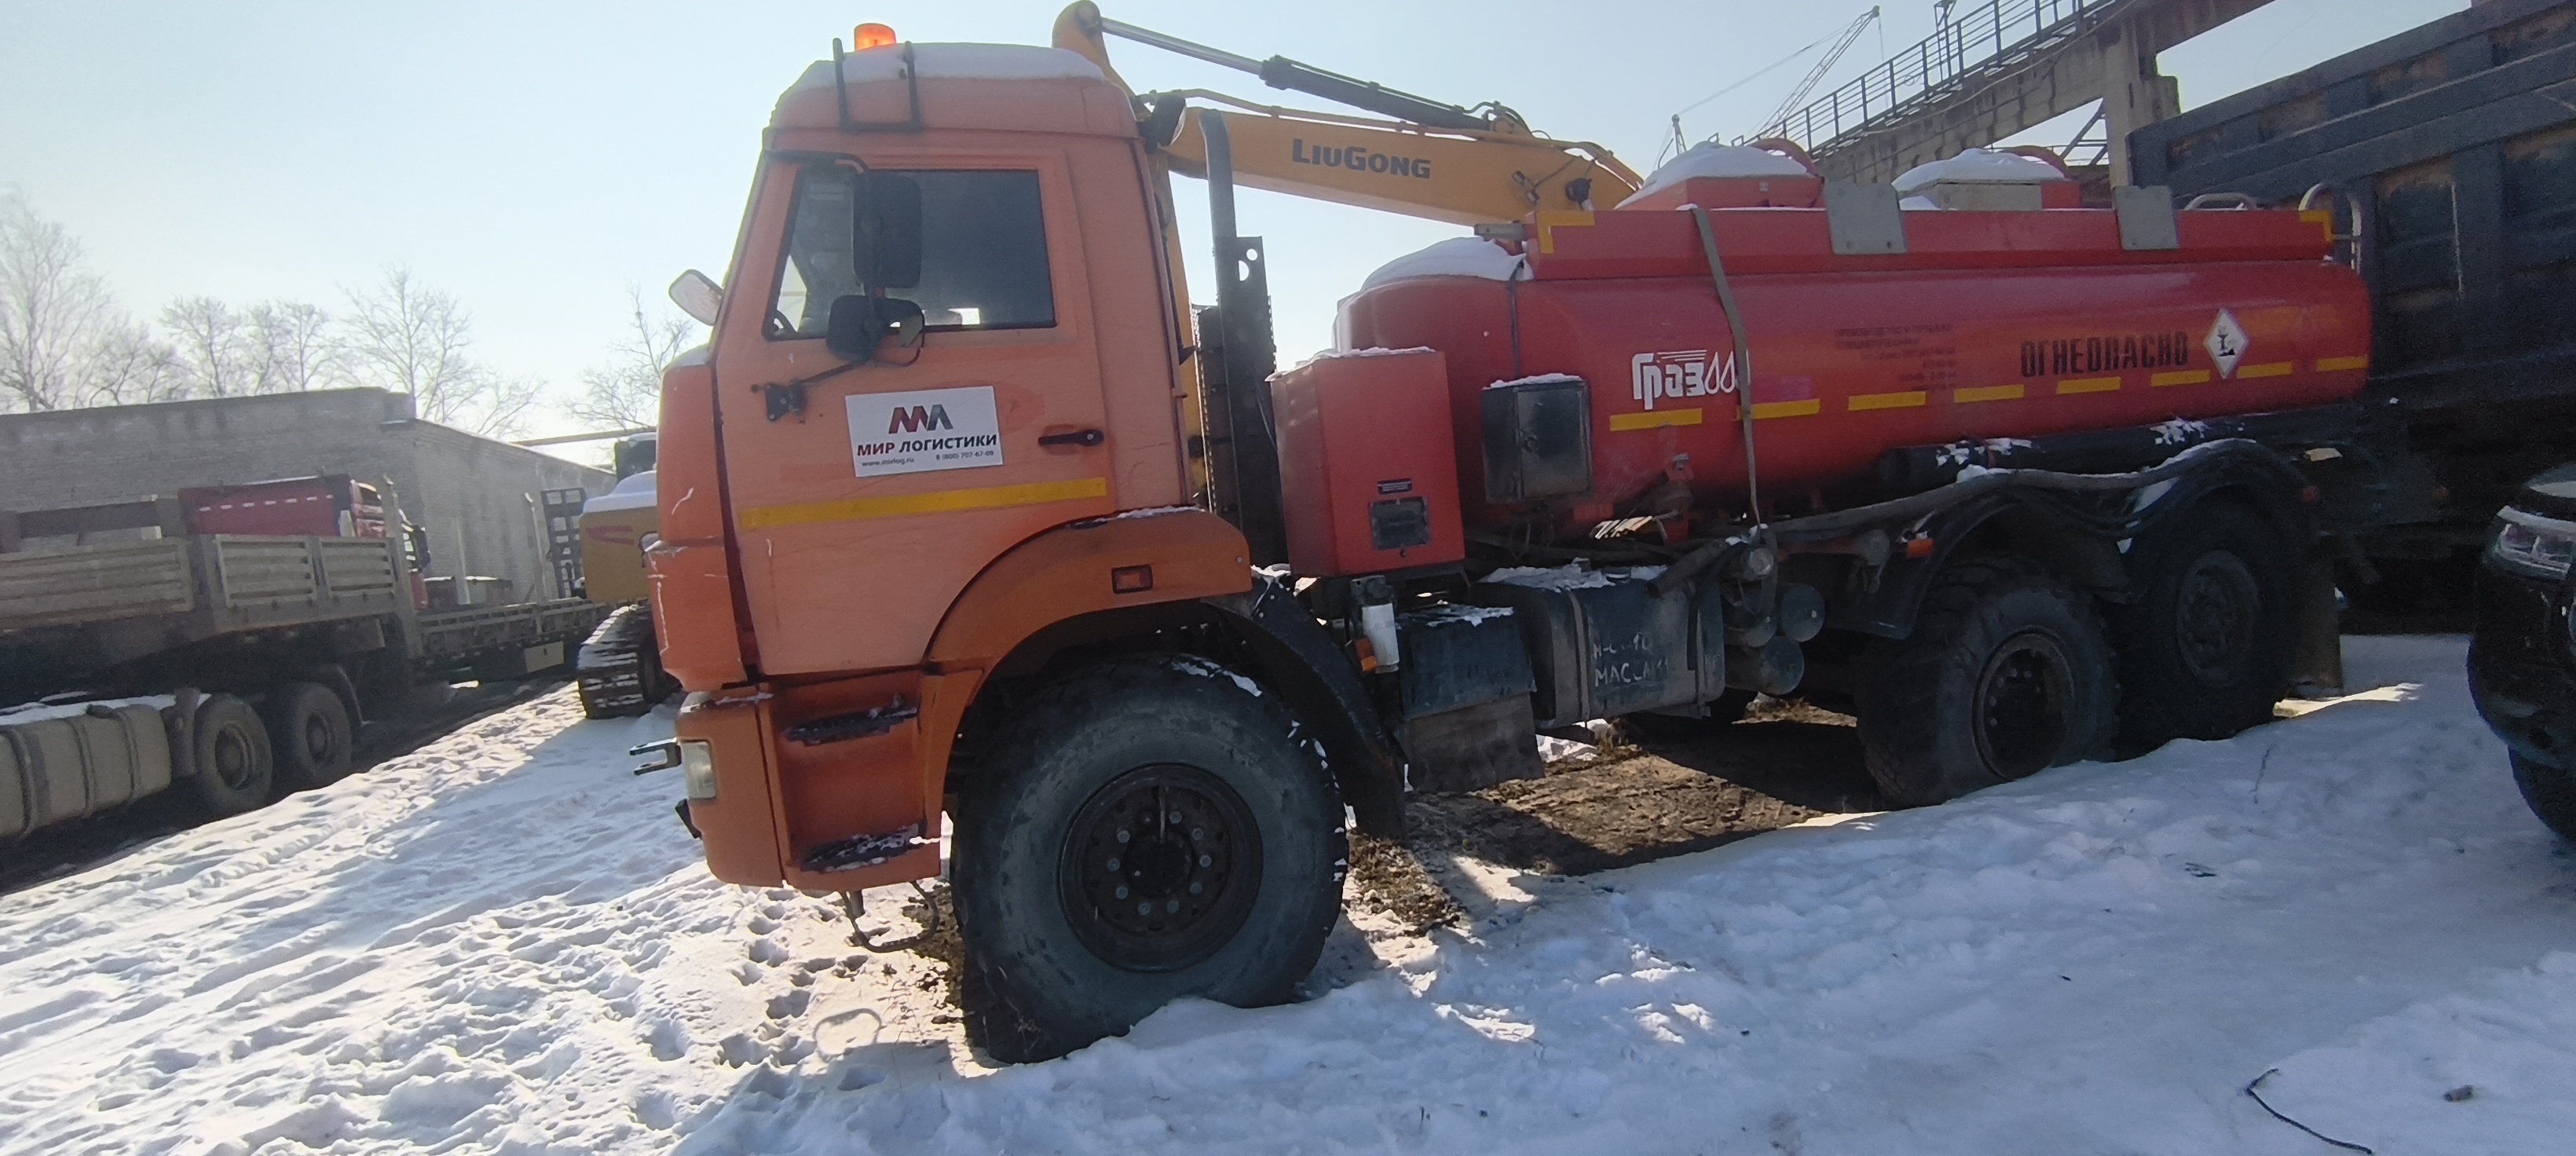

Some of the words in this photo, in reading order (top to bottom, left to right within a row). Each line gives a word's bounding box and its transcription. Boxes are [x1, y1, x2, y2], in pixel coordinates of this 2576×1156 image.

[2021, 331, 2189, 378] ОГНЕОПАСНО
[857, 442, 895, 456] МИР
[898, 434, 997, 453] ЛОГИСТИКИ
